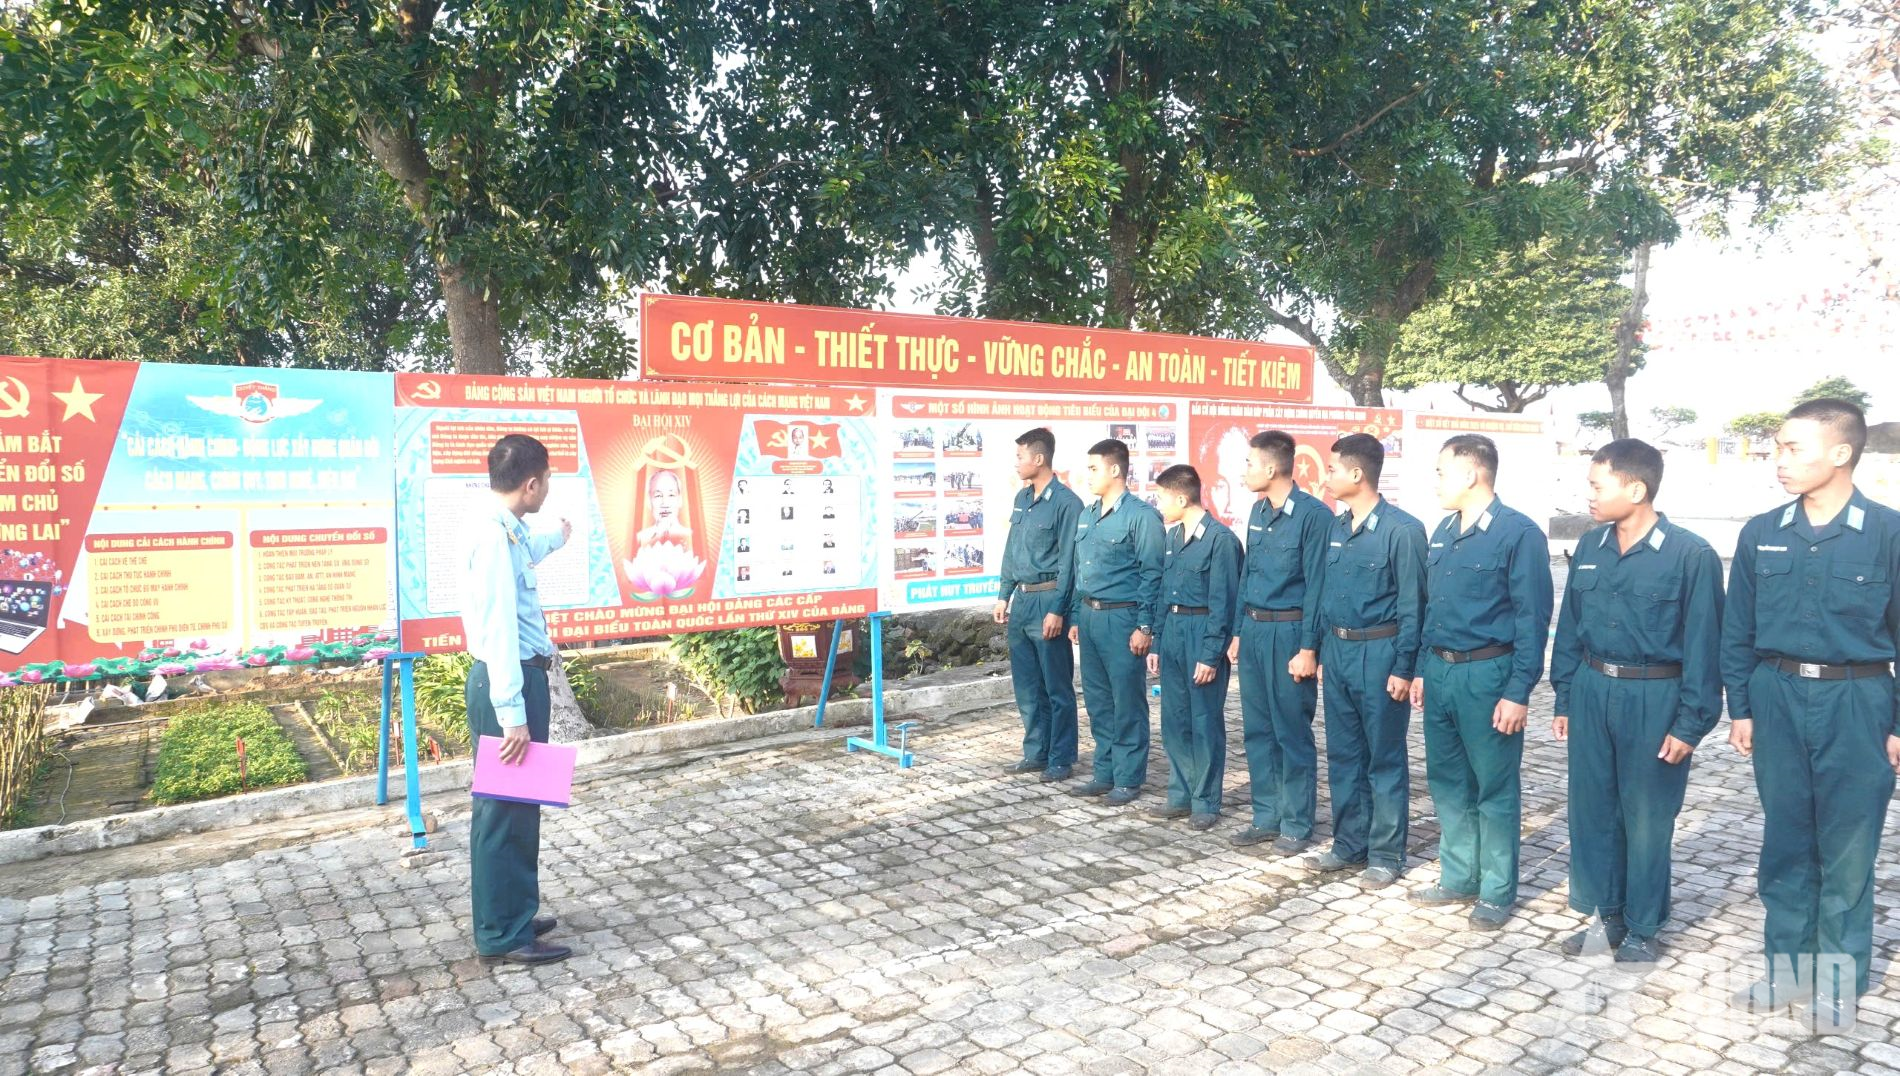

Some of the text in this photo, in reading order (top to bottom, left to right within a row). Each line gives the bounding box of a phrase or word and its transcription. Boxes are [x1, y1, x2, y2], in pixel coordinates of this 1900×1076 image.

[671, 319, 714, 362] CƠ
[723, 313, 785, 364] BẢN
[814, 322, 888, 369] THIẾT
[896, 334, 960, 380] THỰC
[984, 336, 1044, 377] VỮNG
[1051, 336, 1107, 379] CHẮC
[1125, 351, 1153, 382] AN
[1158, 348, 1206, 384] TOÀN
[1223, 351, 1257, 387] TIẾT
[1261, 356, 1300, 394] KIỆM
[633, 413, 692, 430] ĐẠI HỘI XIV
[27, 430, 62, 453] BẮT
[25, 458, 56, 482] ĐỔI
[61, 459, 85, 482] SỐ
[22, 489, 58, 511] CHỦ
[573, 607, 616, 623] CHÀO
[620, 603, 665, 619] MỪNG
[669, 604, 693, 616] ĐẠI
[698, 600, 720, 614] HỘI
[725, 598, 763, 611] ĐẢNG
[766, 596, 793, 608] CÁC
[797, 593, 823, 606] CẤP
[422, 633, 462, 648] TIẾN
[562, 625, 589, 639] ĐẠI
[594, 620, 630, 634] BIỂU
[633, 618, 672, 631] TOÀN
[676, 613, 714, 629] QUỐC
[718, 612, 745, 625] LẦN
[749, 608, 775, 622] THỨ
[778, 610, 799, 620] XIV
[803, 605, 828, 618] CỦA
[831, 602, 865, 616] ĐẢNG
